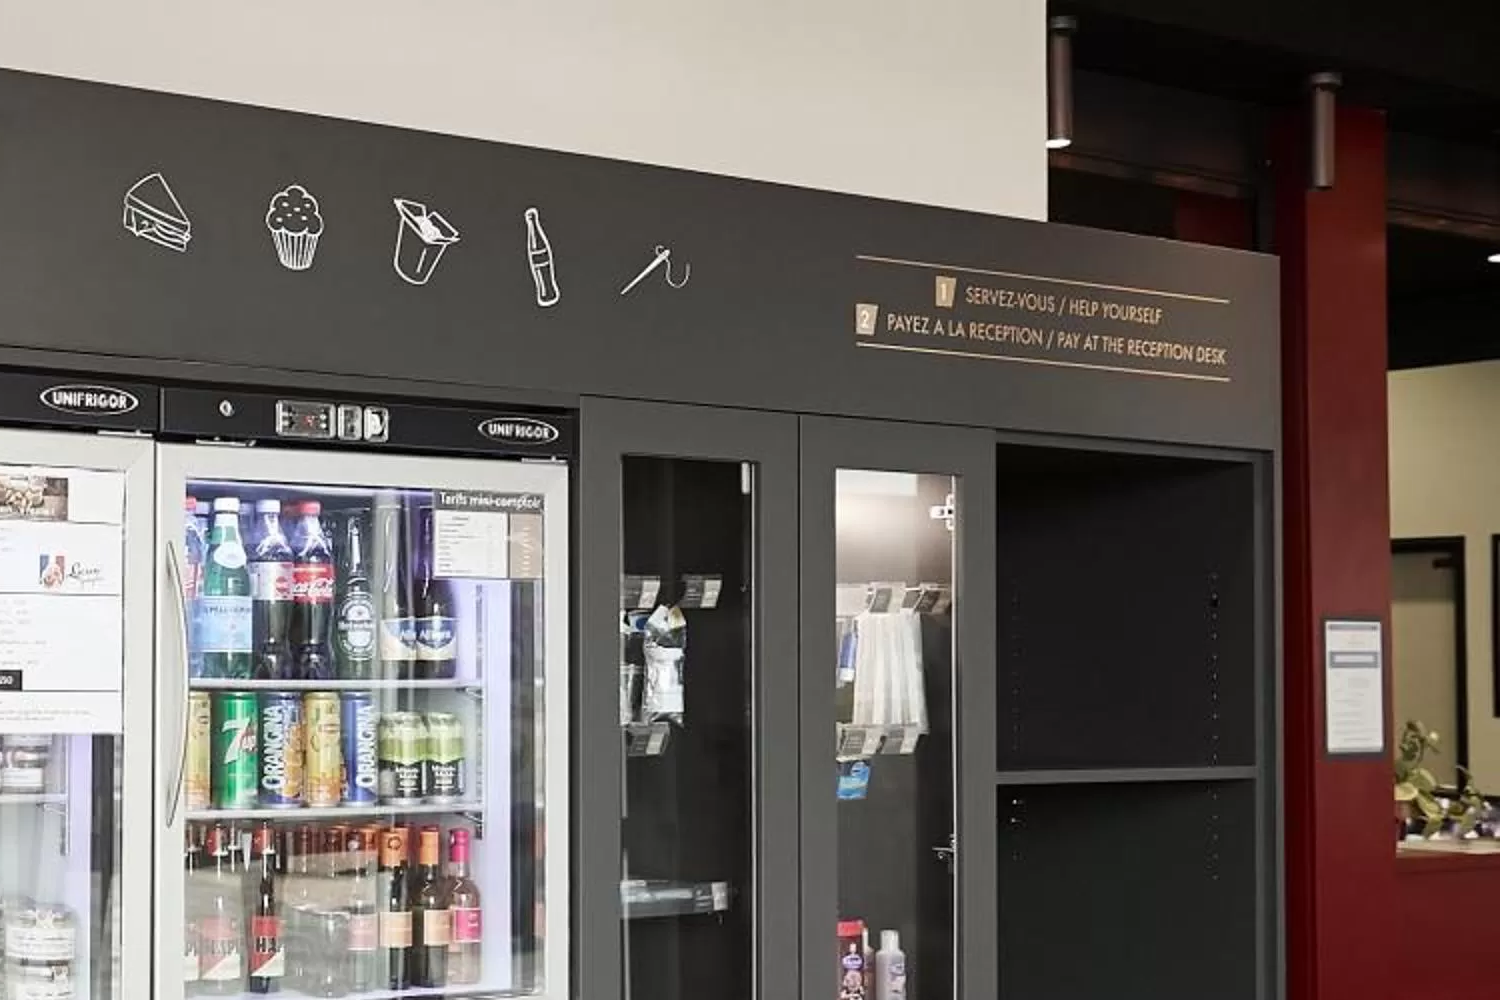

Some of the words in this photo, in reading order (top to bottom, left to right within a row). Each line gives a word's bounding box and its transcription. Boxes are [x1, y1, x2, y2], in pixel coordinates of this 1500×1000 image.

[965, 286, 1055, 313] SERVEZ-VOUS
[1069, 298, 1099, 317] HELP
[1100, 303, 1163, 325] YOURSELF
[887, 313, 929, 335] PAYEZ
[950, 320, 965, 337] LA
[969, 322, 1043, 346] RECEPTION
[1057, 331, 1081, 350] PAY
[1084, 335, 1100, 351] AT
[1102, 335, 1125, 354] THE
[1127, 339, 1194, 362] RECEPTION
[1195, 347, 1228, 365] DESK
[51, 389, 128, 410] UNIFRIGOR
[487, 421, 551, 441] UNIFRIGOR
